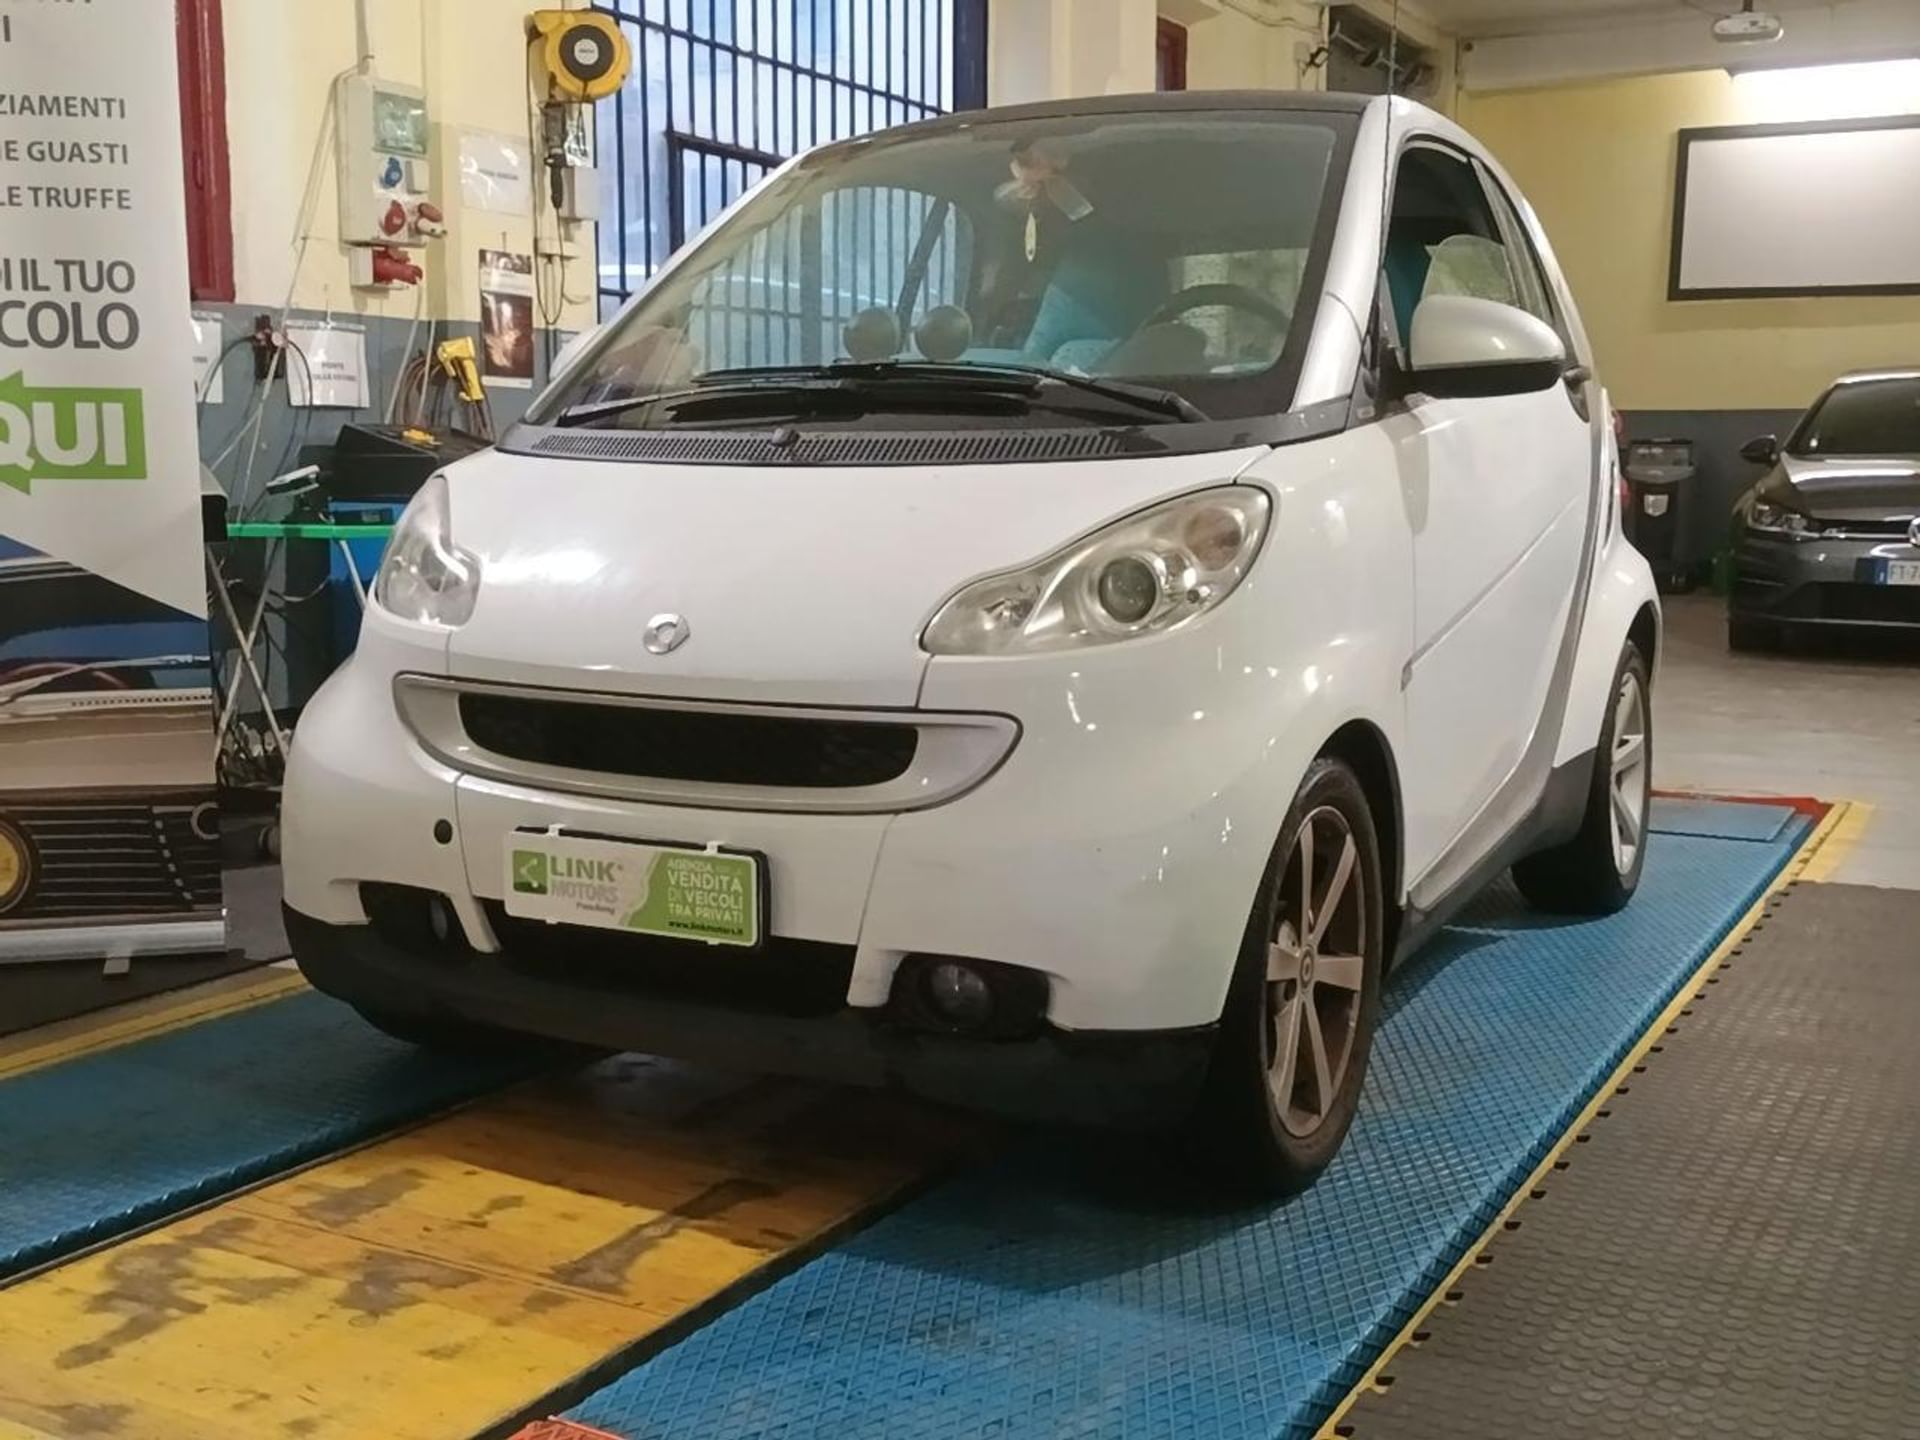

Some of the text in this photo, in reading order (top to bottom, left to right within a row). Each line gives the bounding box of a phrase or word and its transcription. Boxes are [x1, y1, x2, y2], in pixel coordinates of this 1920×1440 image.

[27, 141, 129, 165] GUASTI
[27, 187, 132, 210] TRUFFE
[20, 258, 51, 291] IL
[54, 260, 136, 293] TUO
[0, 300, 140, 350] COLO
[550, 856, 616, 882] LINK
[551, 880, 619, 903] MOTORS
[667, 870, 744, 893] VENDITA
[684, 889, 744, 910] VEICOLI
[668, 903, 744, 923] TRA PRIVATI
